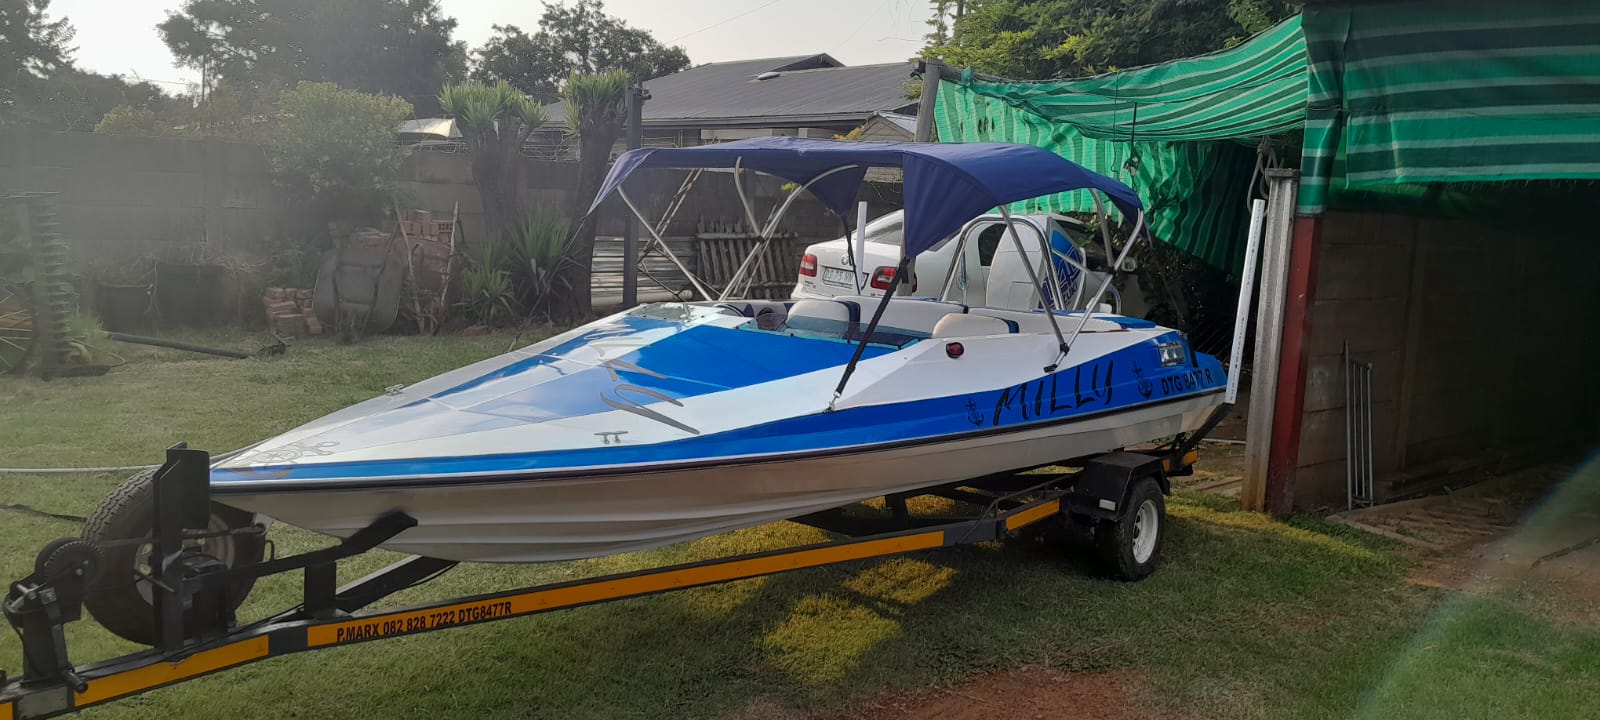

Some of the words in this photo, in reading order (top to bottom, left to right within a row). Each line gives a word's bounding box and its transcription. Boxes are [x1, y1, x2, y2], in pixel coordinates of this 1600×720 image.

[993, 359, 1114, 426] MILLY
[1160, 375, 1183, 395] DTG
[1183, 369, 1204, 390] 8477
[1204, 367, 1214, 384] R
[336, 623, 380, 643] P.MARX
[383, 620, 403, 635] 082
[406, 615, 426, 632] 828
[429, 611, 456, 628] 7222
[458, 601, 512, 623] DTG8477R
